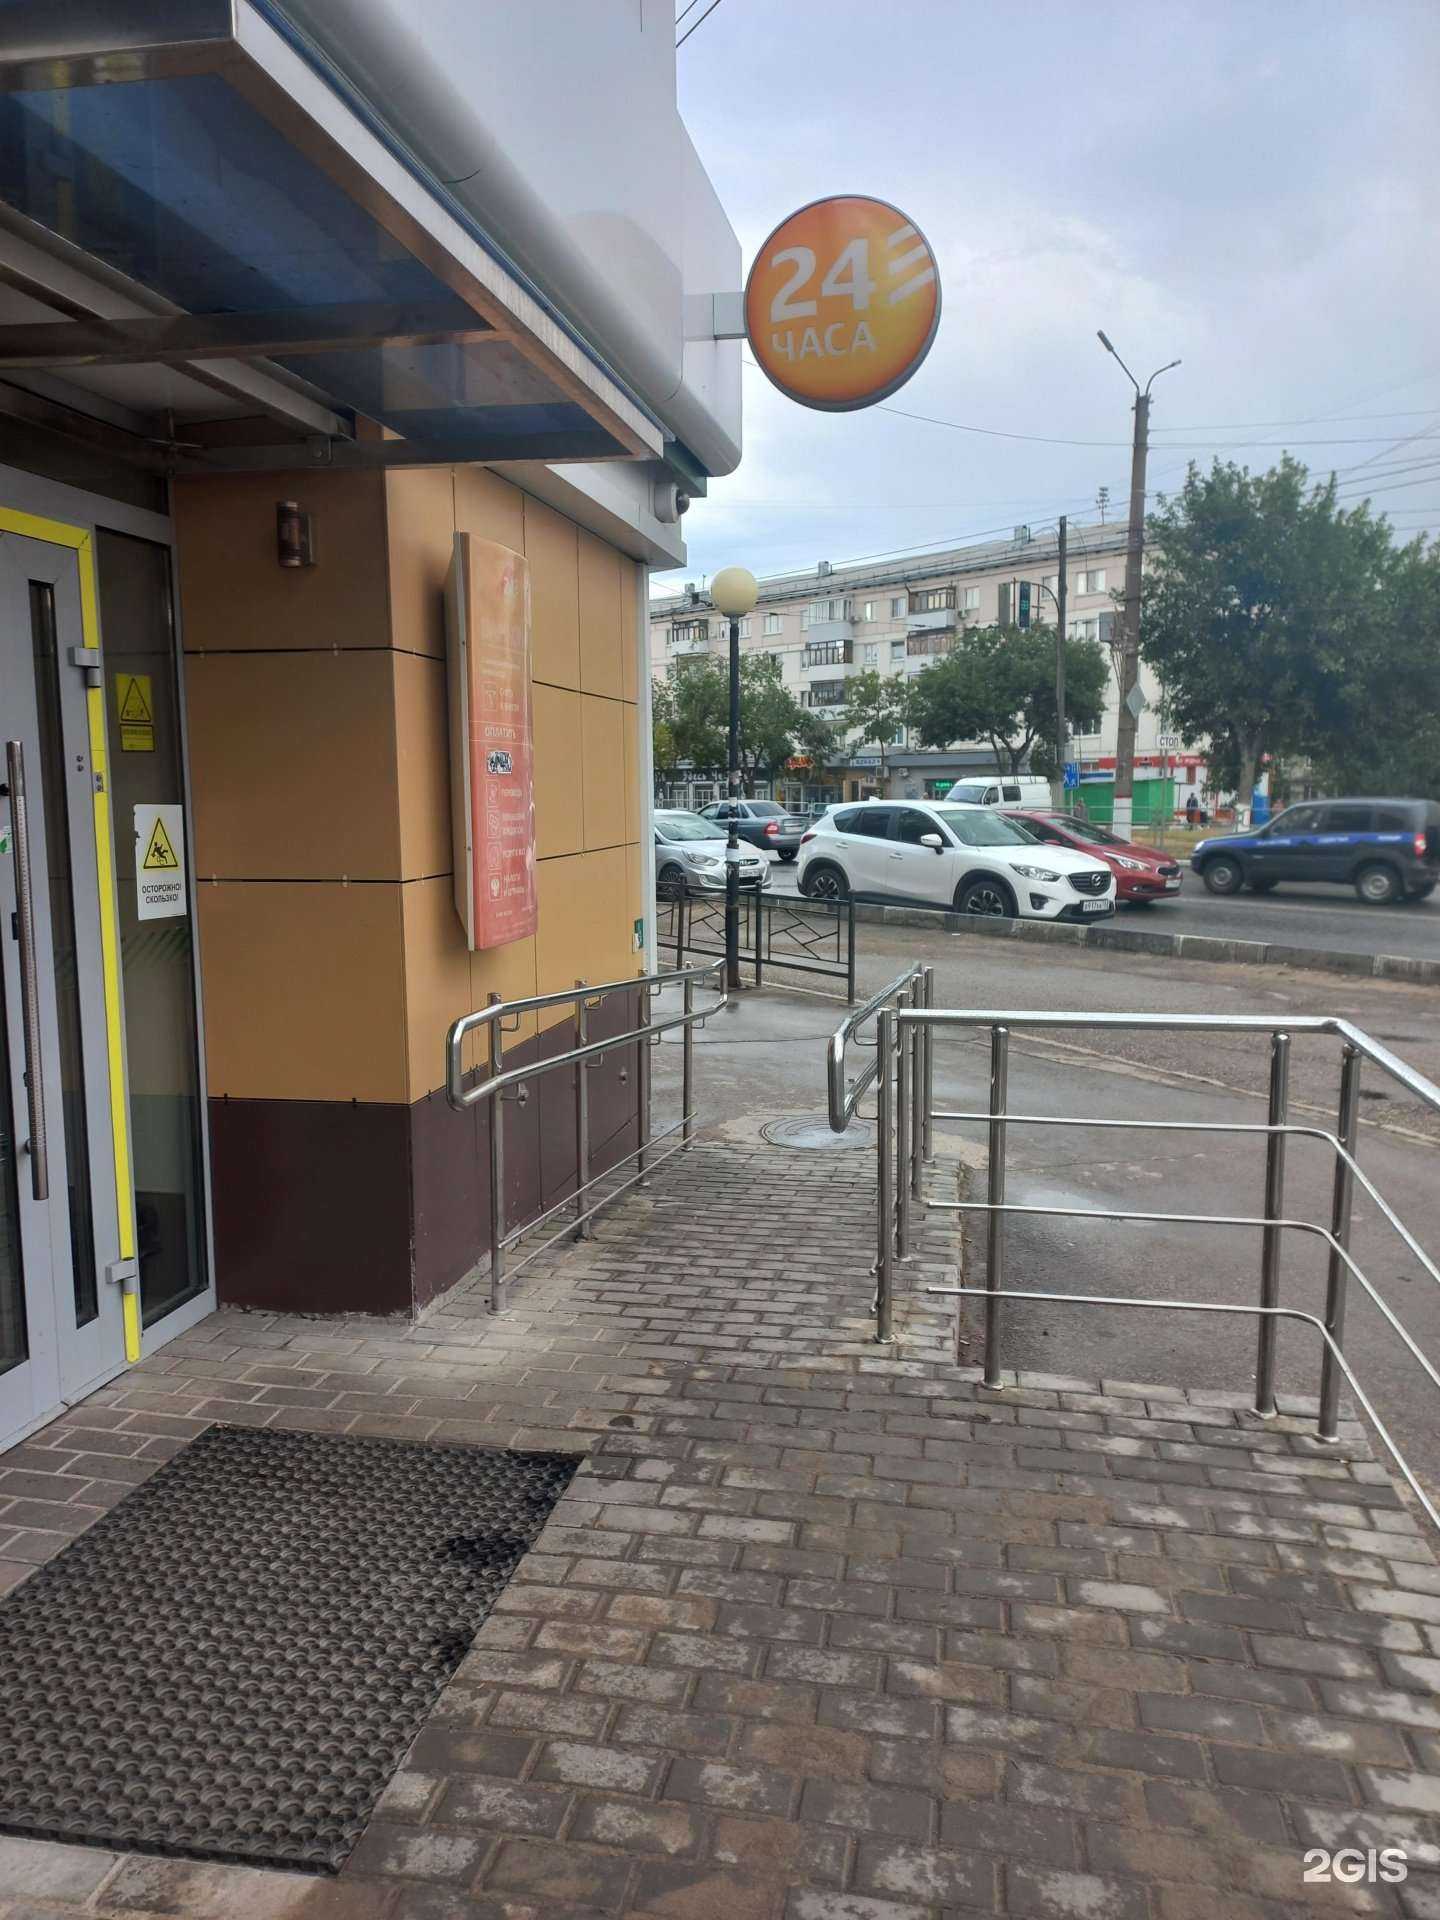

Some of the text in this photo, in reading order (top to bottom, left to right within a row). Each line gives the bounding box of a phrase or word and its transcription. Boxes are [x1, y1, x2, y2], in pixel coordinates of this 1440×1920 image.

[770, 238, 876, 324] 24
[771, 320, 878, 362] ЧАСА
[142, 883, 182, 894] ОСТОРОЖНО!
[145, 894, 179, 904] СКОЛЬЗКО!
